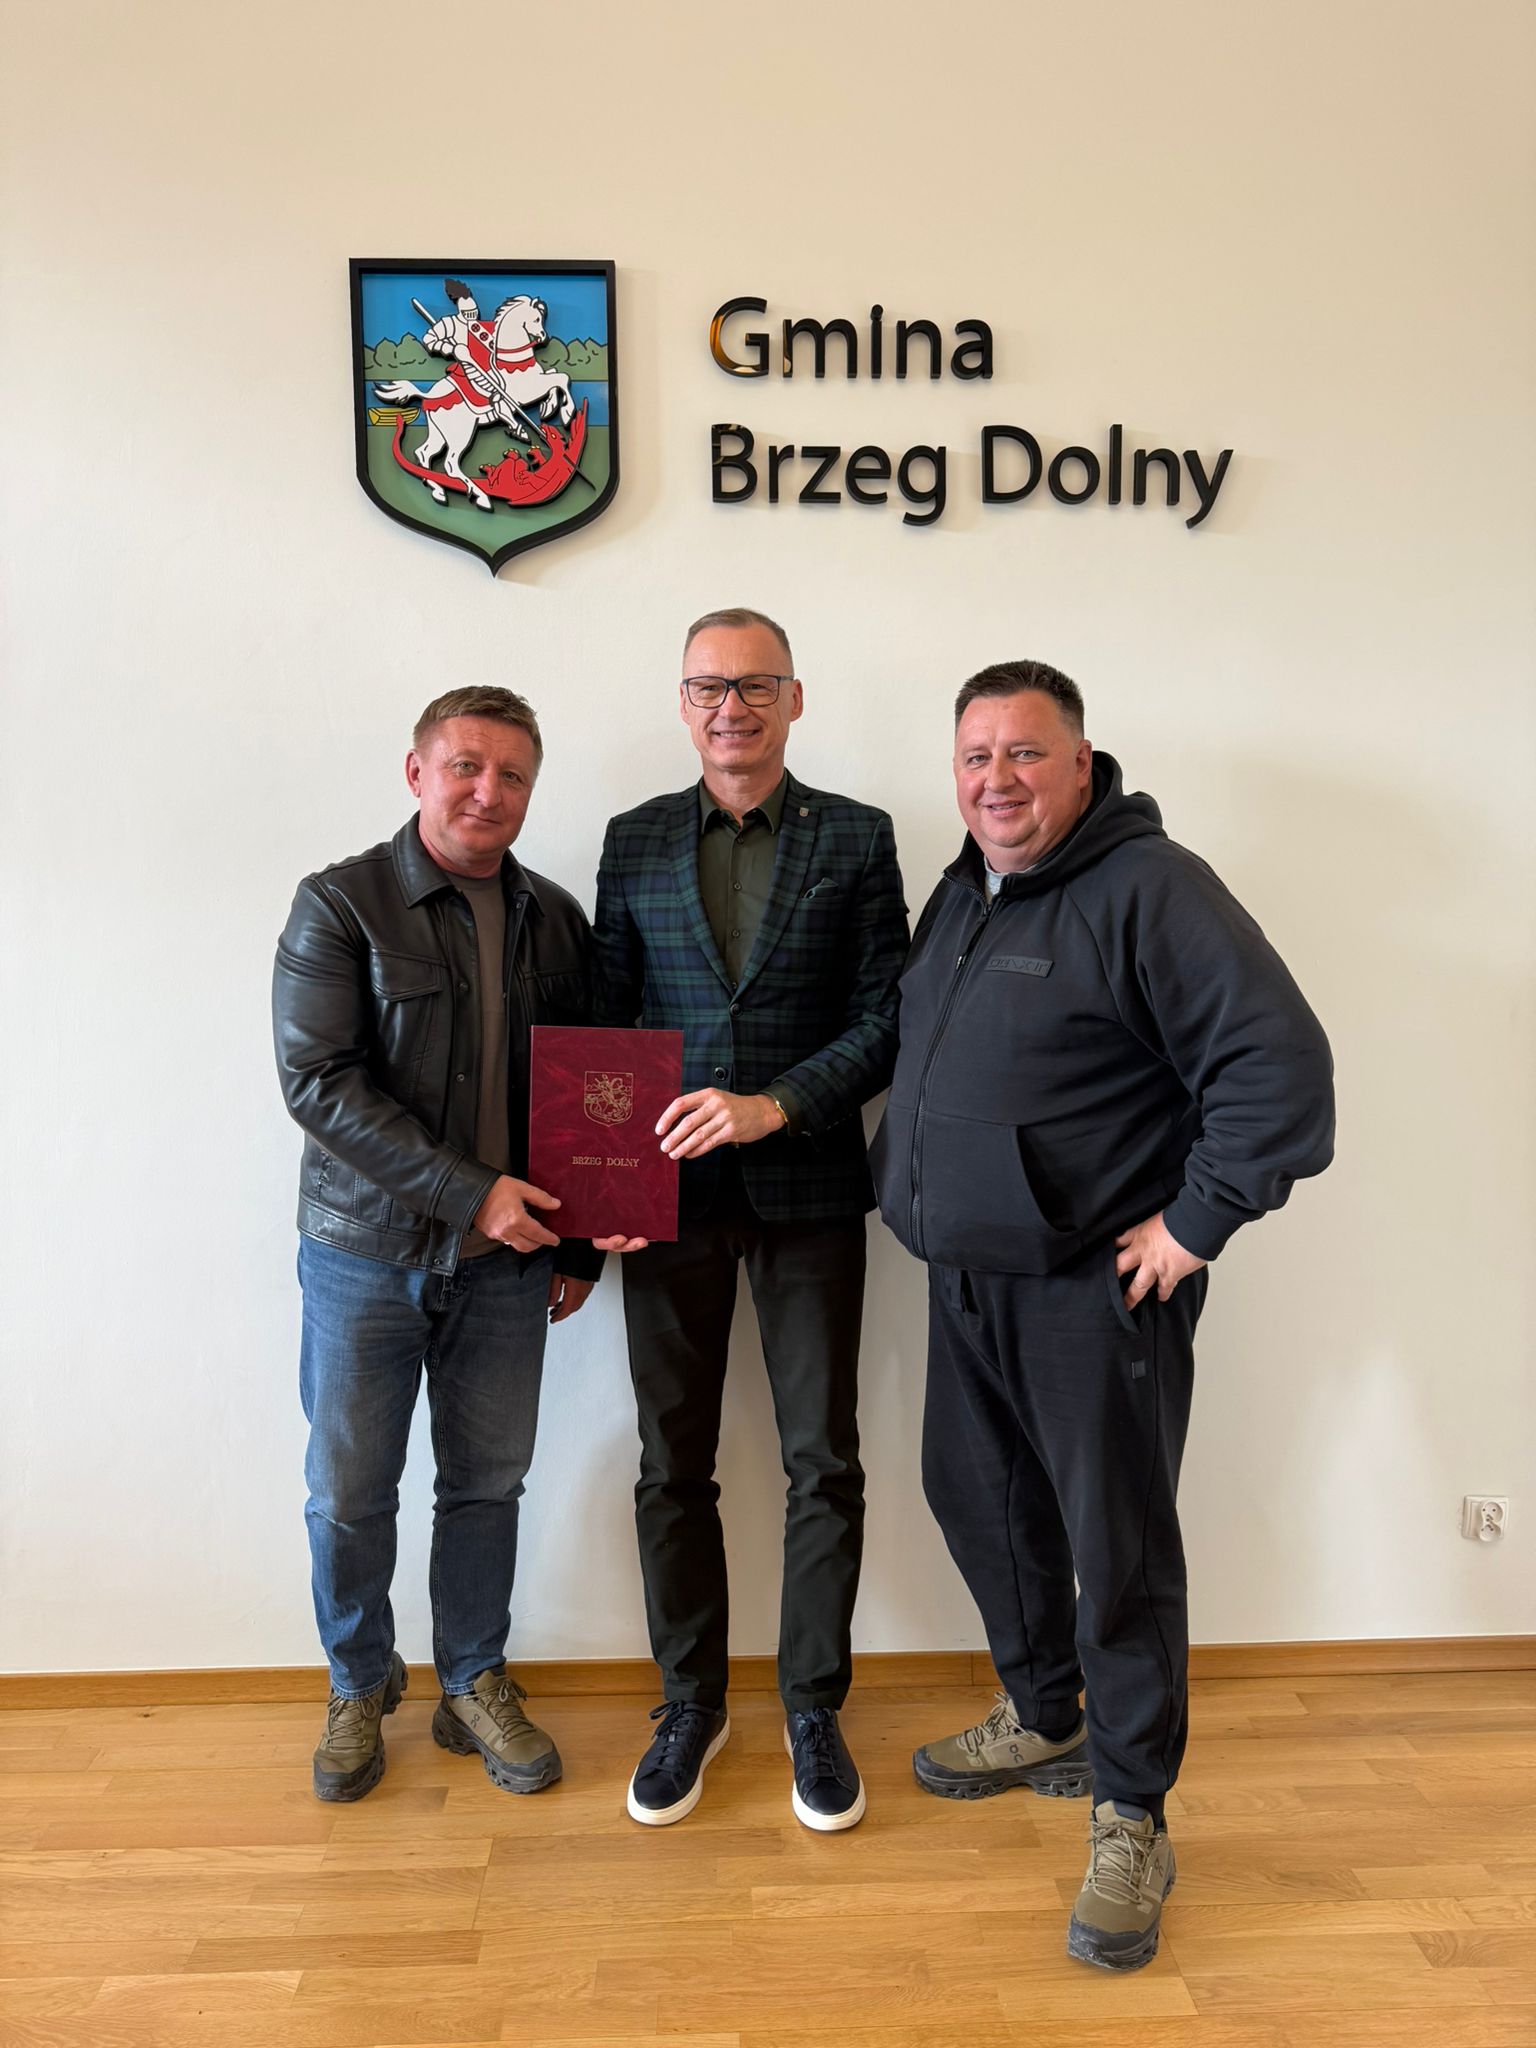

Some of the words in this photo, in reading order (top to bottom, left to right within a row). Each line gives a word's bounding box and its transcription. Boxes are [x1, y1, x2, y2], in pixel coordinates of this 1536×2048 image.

[709, 296, 993, 380] Gmina
[711, 424, 947, 527] Brzeg
[981, 424, 1234, 529] Dolny
[572, 1156, 602, 1166] BRZEG
[606, 1157, 640, 1168] DOLNY
